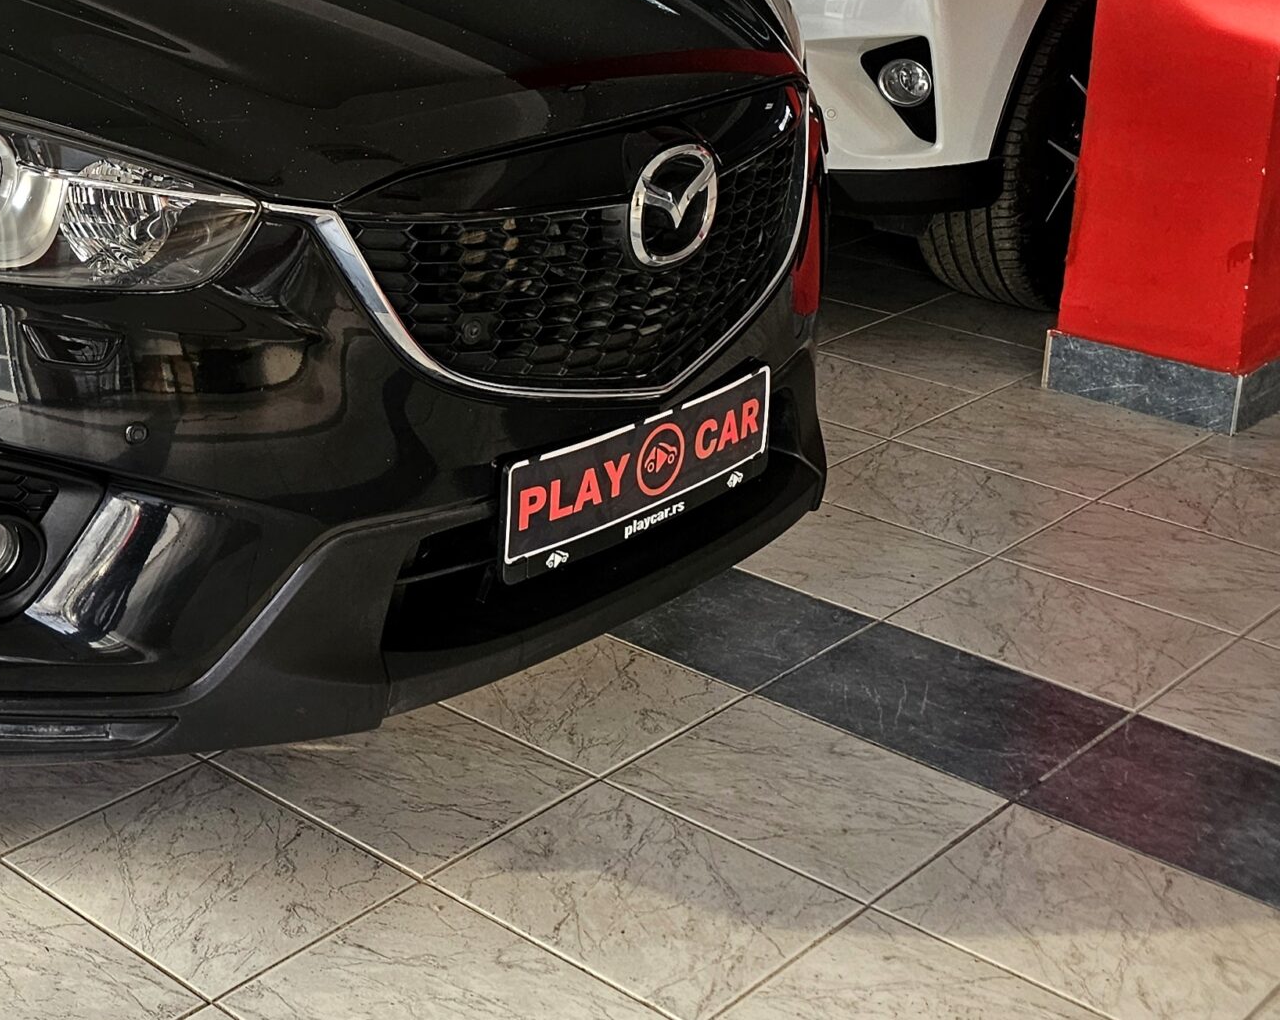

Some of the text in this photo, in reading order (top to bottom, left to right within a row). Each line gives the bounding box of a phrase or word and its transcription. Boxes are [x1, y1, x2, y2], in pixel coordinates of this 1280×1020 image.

[518, 397, 761, 531] PLAY CAR
[623, 501, 686, 540] playcar.rs
